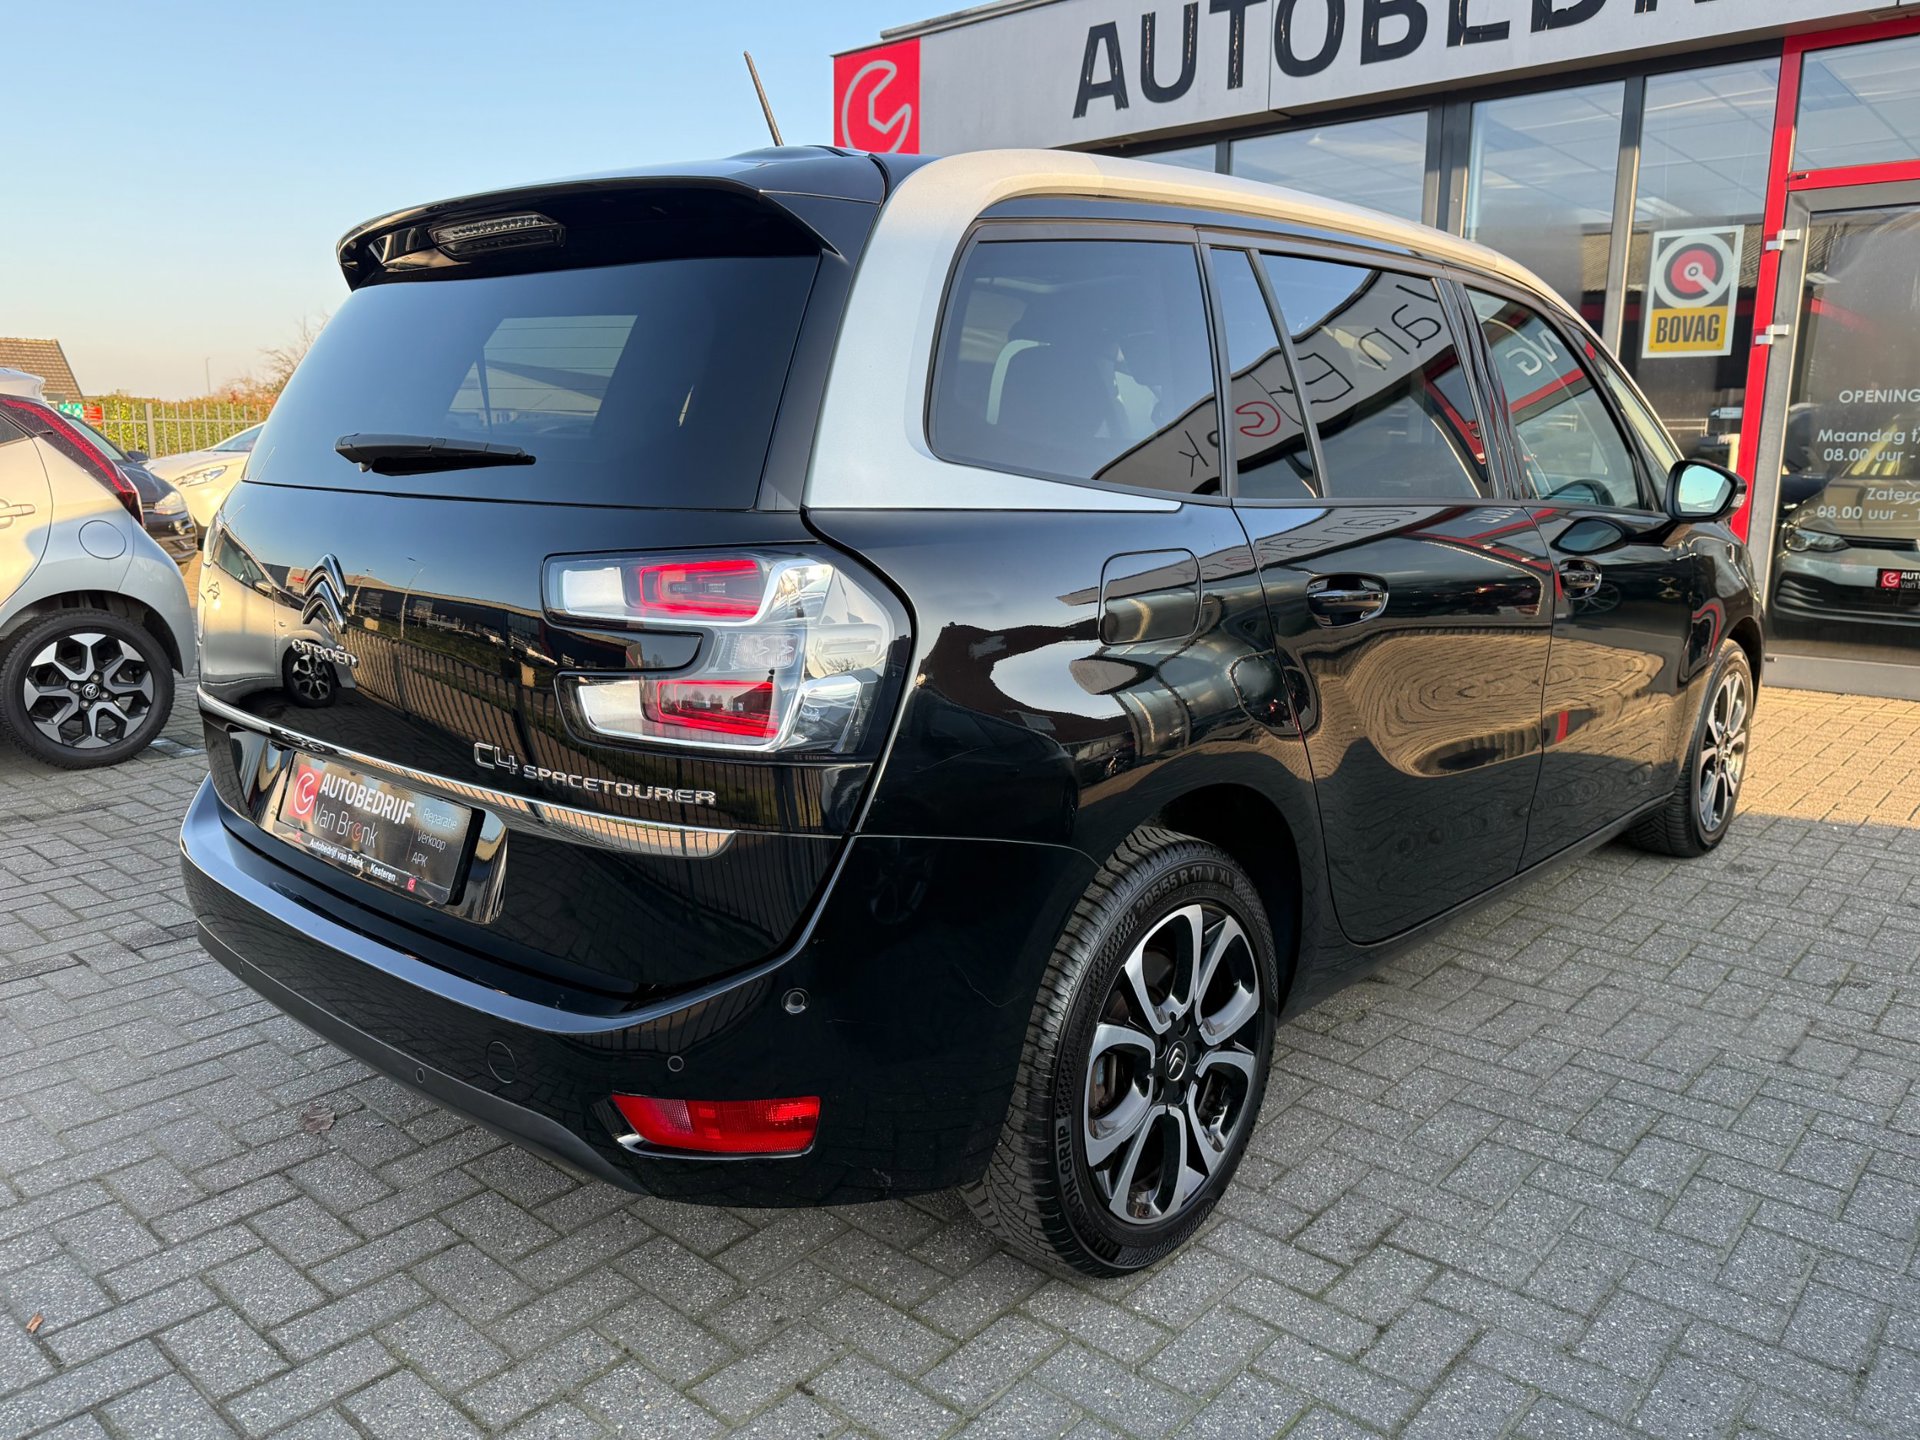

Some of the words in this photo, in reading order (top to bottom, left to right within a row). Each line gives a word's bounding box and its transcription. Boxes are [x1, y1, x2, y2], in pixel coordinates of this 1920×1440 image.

[1655, 313, 1720, 343] BOVAG
[1817, 428, 1905, 445] Maandag
[1823, 448, 1869, 461] 08.00
[1875, 451, 1904, 461] uur
[1816, 505, 1862, 519] 08.00
[1868, 509, 1896, 520] uur
[291, 639, 359, 668] CITROËN
[473, 742, 518, 775] C4
[523, 765, 717, 806] SPACETOURER
[319, 773, 415, 825] AUTOBEDRIJF
[313, 801, 336, 831] Van
[423, 807, 457, 830] Reparatie
[417, 829, 447, 853] Verkoop
[309, 838, 338, 857] Autobedrijf
[370, 862, 397, 882] Kesteren
[411, 851, 428, 868] APK
[1136, 873, 1178, 911] 205/55
[1179, 869, 1189, 884] R
[1190, 866, 1203, 881] 17
[1206, 866, 1215, 881] V
[1218, 868, 1232, 887] XL
